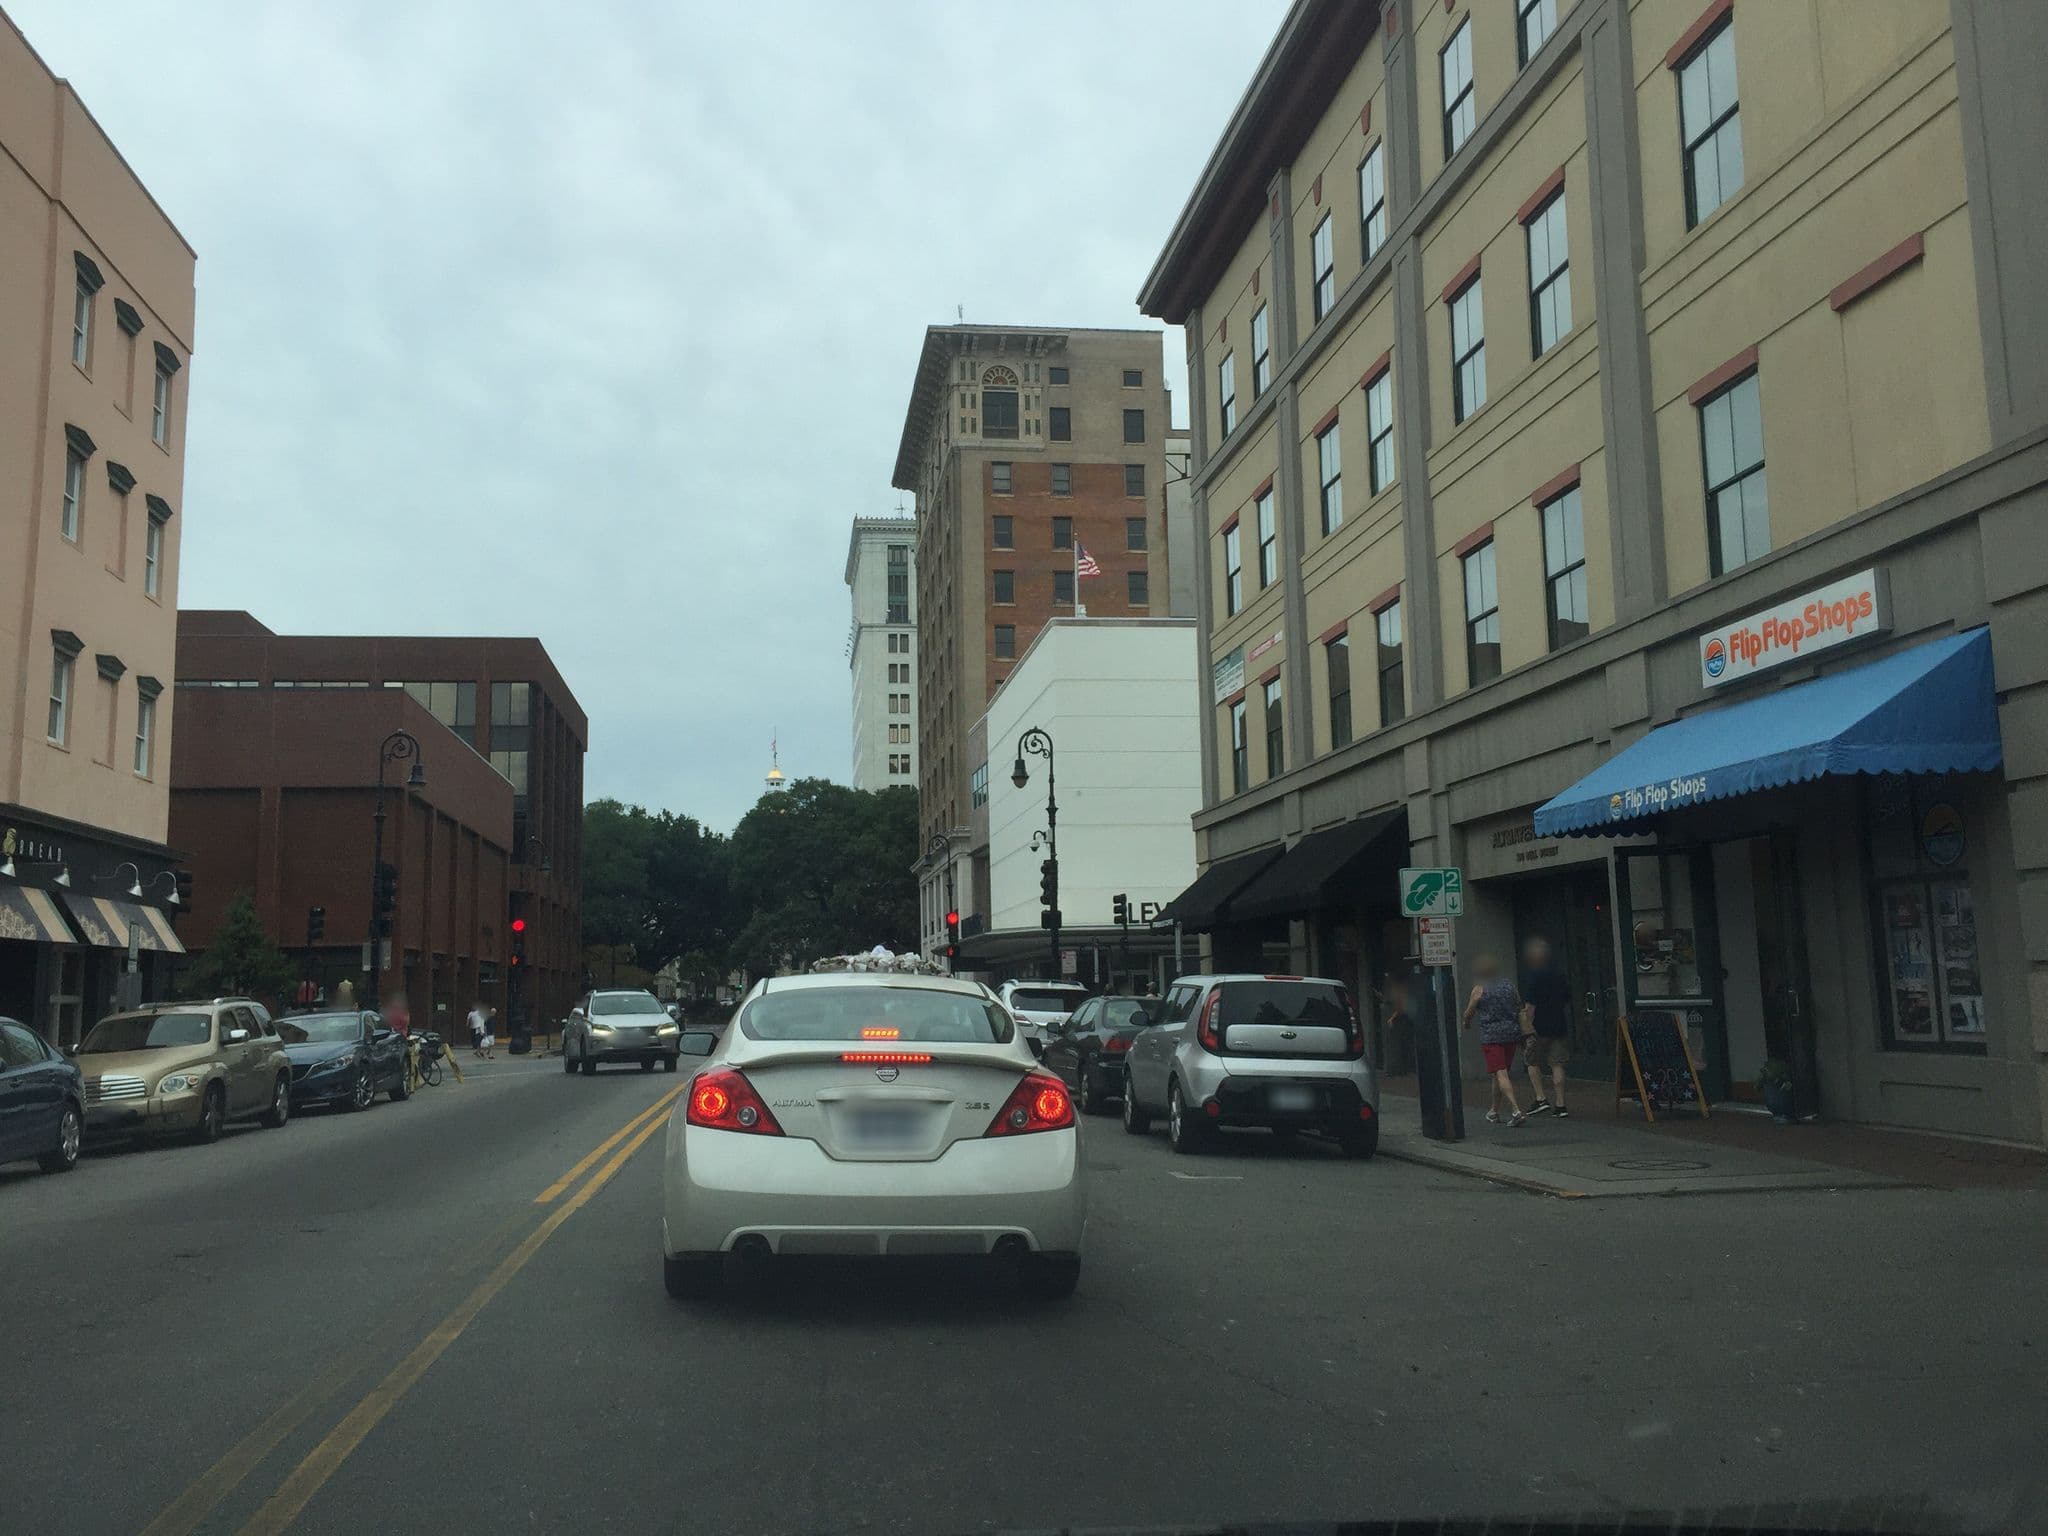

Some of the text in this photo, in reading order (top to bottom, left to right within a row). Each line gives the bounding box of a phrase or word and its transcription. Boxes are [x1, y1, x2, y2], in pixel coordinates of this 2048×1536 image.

[1625, 776, 1706, 815] Flip Flop Shops
[19, 839, 62, 862] BREAD
[1445, 871, 1459, 887] 2
